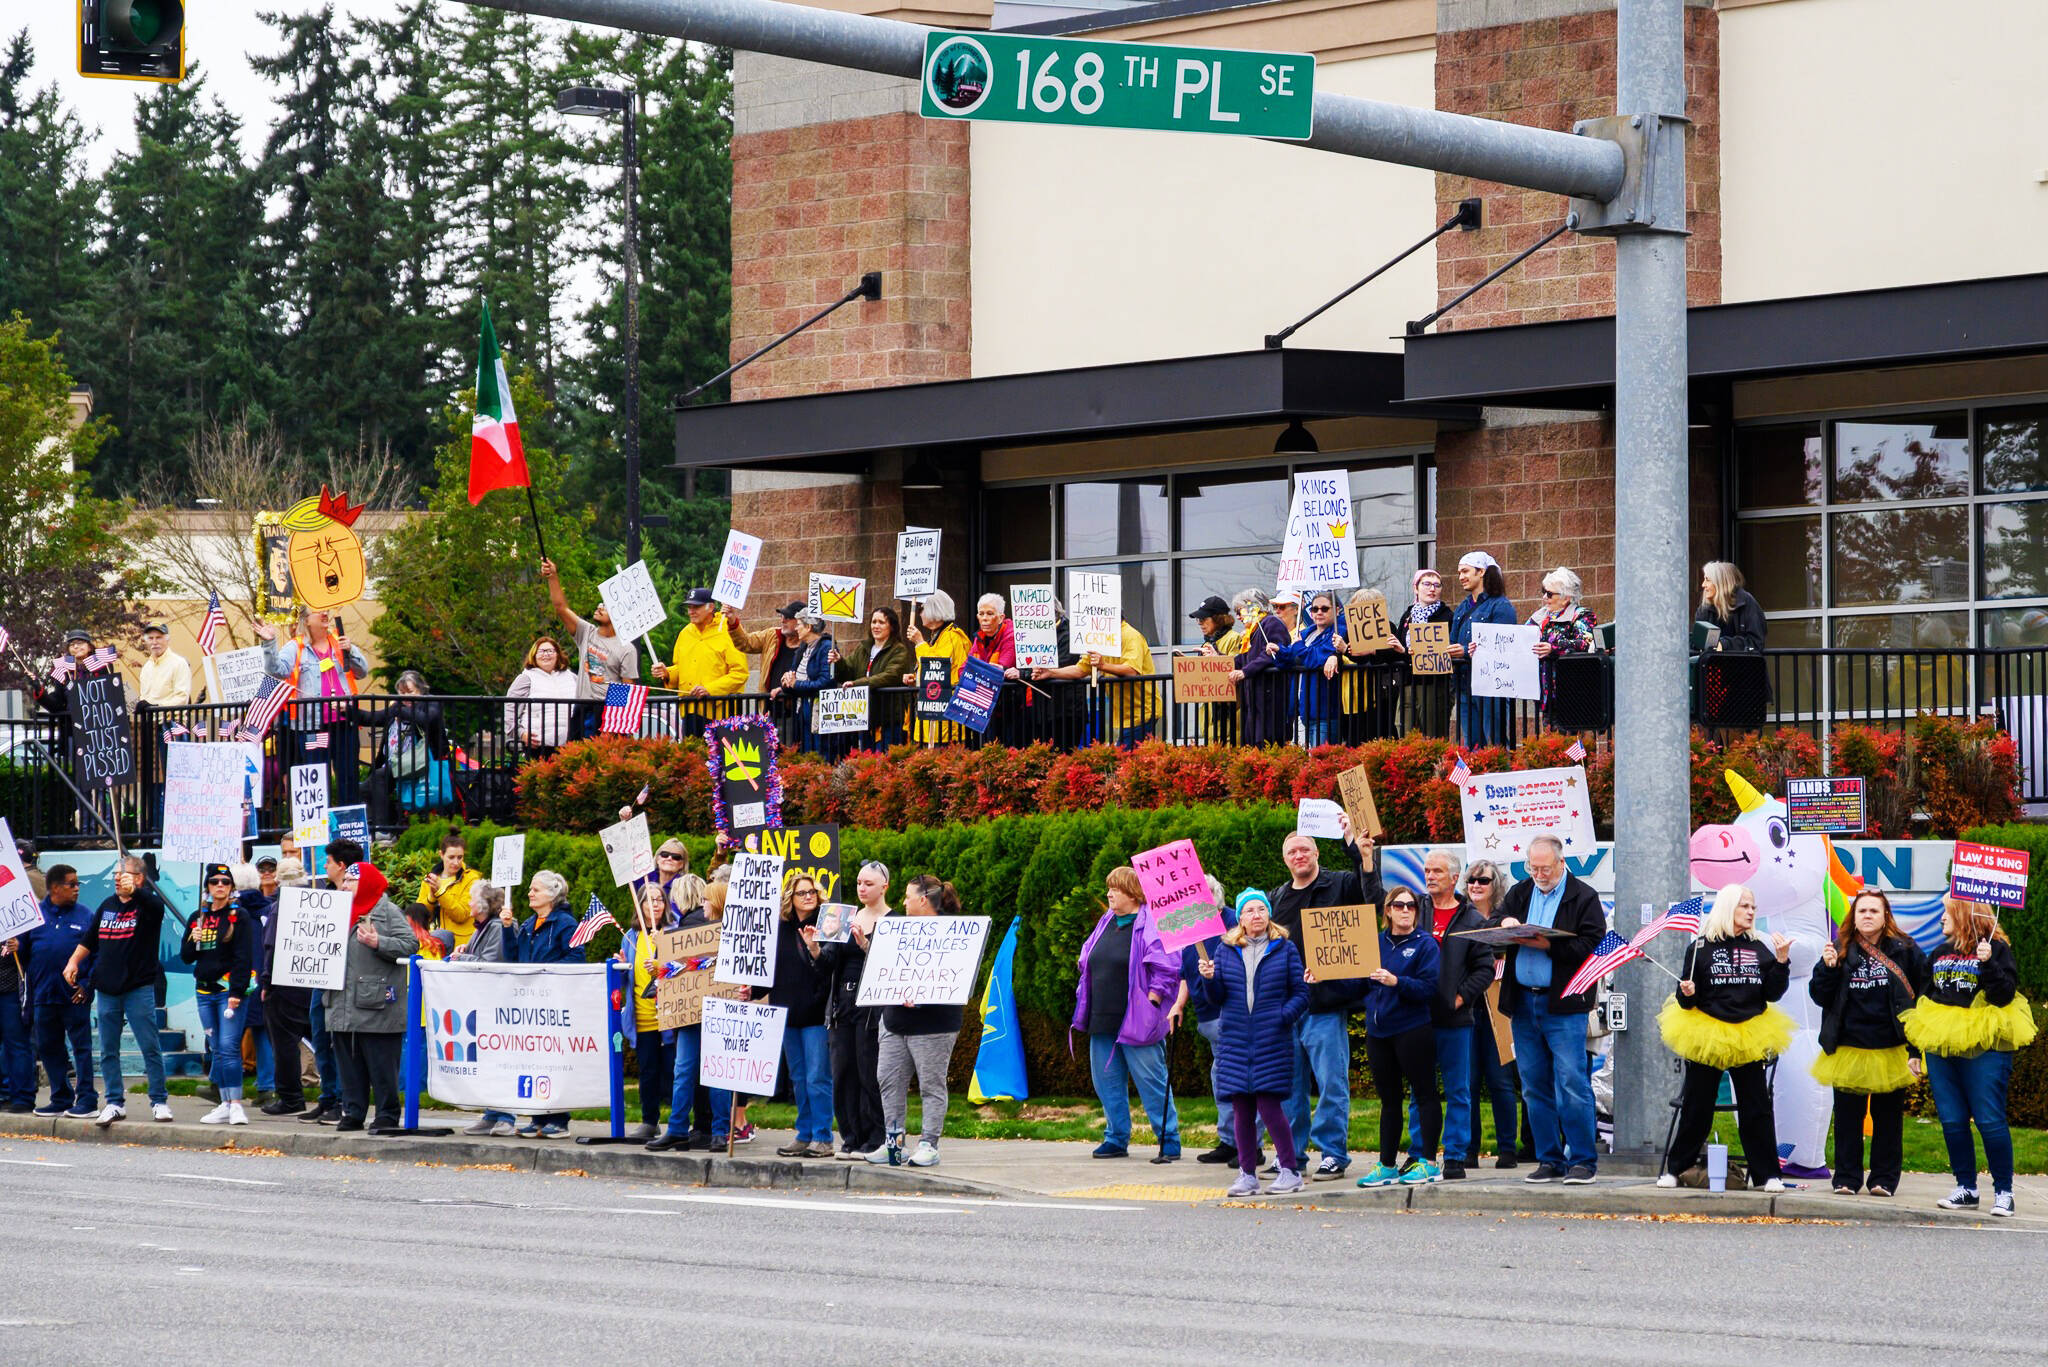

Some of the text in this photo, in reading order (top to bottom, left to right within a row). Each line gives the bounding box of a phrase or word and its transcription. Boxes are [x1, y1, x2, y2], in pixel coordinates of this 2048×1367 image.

[1016, 49, 1295, 123] 168 TH PL SE
[1301, 479, 1337, 495] KINGS
[1303, 498, 1347, 517] BELONG
[1306, 521, 1320, 538] IN
[731, 540, 743, 555] NO
[905, 536, 933, 548] Believe
[1308, 540, 1341, 560] FAIRY
[728, 553, 749, 571] KINGS
[724, 565, 746, 584] SINCE
[900, 566, 932, 576] Democracy
[1310, 560, 1349, 582] TALES
[720, 578, 742, 599] 1776
[909, 577, 928, 585] Justice
[1077, 573, 1109, 595] THE
[270, 595, 293, 609] TRUMP
[1012, 589, 1051, 603] UNPAID
[810, 598, 818, 614] NO
[1014, 604, 1050, 617] PISSED
[1348, 603, 1381, 623] FUCK
[1015, 619, 1055, 630] DEFENDER
[1074, 615, 1115, 632] IS NOT
[1354, 618, 1387, 642] ICE
[1015, 632, 1026, 641] OF
[1074, 632, 1118, 647] A CRIME
[1414, 625, 1443, 643] ICE
[1016, 643, 1057, 656] DEMOCRACY
[929, 660, 942, 670] NO
[1035, 655, 1055, 665] USA
[1177, 660, 1233, 673] NO KINGS
[1414, 652, 1452, 673] GESTAPO
[924, 670, 945, 681] KING
[964, 671, 974, 680] NO
[975, 676, 990, 688] KINGS
[77, 678, 107, 706] NOT
[833, 690, 849, 701] YOU
[1181, 683, 1235, 697] AMERICA
[821, 701, 839, 713] NOT
[952, 698, 988, 719] AMERICA
[81, 702, 113, 730] PAID
[85, 725, 119, 754] JUST
[83, 747, 130, 781] PISSED
[299, 767, 319, 787] NO
[1485, 780, 1563, 800] Democracy
[1790, 780, 1861, 794] HANDS OFF!
[294, 788, 324, 805] KING
[301, 805, 324, 822] BUT
[1489, 799, 1566, 816] No Crowns
[351, 821, 365, 829] FEAR
[1497, 815, 1561, 829] No Kings
[744, 857, 773, 878] POWER
[772, 865, 780, 873] OF
[1139, 847, 1192, 872] NAVY
[1959, 851, 2023, 870] LAW IS KING
[1155, 866, 1189, 887] VET
[738, 879, 771, 900] PEOPLE
[1150, 883, 1202, 911] AGAINST
[1955, 881, 2022, 900] TRUMP IS NOT
[299, 890, 332, 910] POO
[0, 891, 42, 931] INGS!
[313, 913, 327, 923] you
[722, 904, 772, 935] STRONGER
[1309, 909, 1360, 928] IMPEACH
[108, 919, 137, 929] KINGS
[290, 920, 336, 939] TRUMP
[878, 920, 980, 936] CHECKS AND
[671, 928, 721, 954] HANDS
[1319, 927, 1347, 943] THE
[307, 943, 315, 952] is
[317, 941, 342, 957] OUR
[733, 933, 767, 955] PEOPLE
[897, 937, 970, 951] BALANCES
[895, 951, 951, 967] NOT
[1315, 944, 1360, 967] REGIME
[290, 955, 329, 974] RIGHT
[733, 955, 768, 977] POWER
[1710, 965, 1723, 974] We
[1740, 965, 1761, 975] People
[1933, 960, 1980, 969] ANTI-HATE
[878, 967, 964, 983] PLENARY
[1714, 977, 1727, 985] AM
[1727, 976, 1747, 984] AUNT
[1860, 979, 1876, 989] AUNT
[861, 985, 960, 1001] AUTHORITY
[663, 995, 700, 1016] PUBLIC
[706, 1000, 778, 1018] IF YOU'RE NOT
[495, 1007, 571, 1027] INDIVISIBLE
[667, 1014, 687, 1027] OUR
[477, 1033, 598, 1055] COVINGTON, WA
[723, 1037, 750, 1052] YOU'RE
[438, 1064, 478, 1076] INDIVISIBLE
[702, 1055, 774, 1083] ASSISTING
[1674, 1058, 1682, 1073] 3
